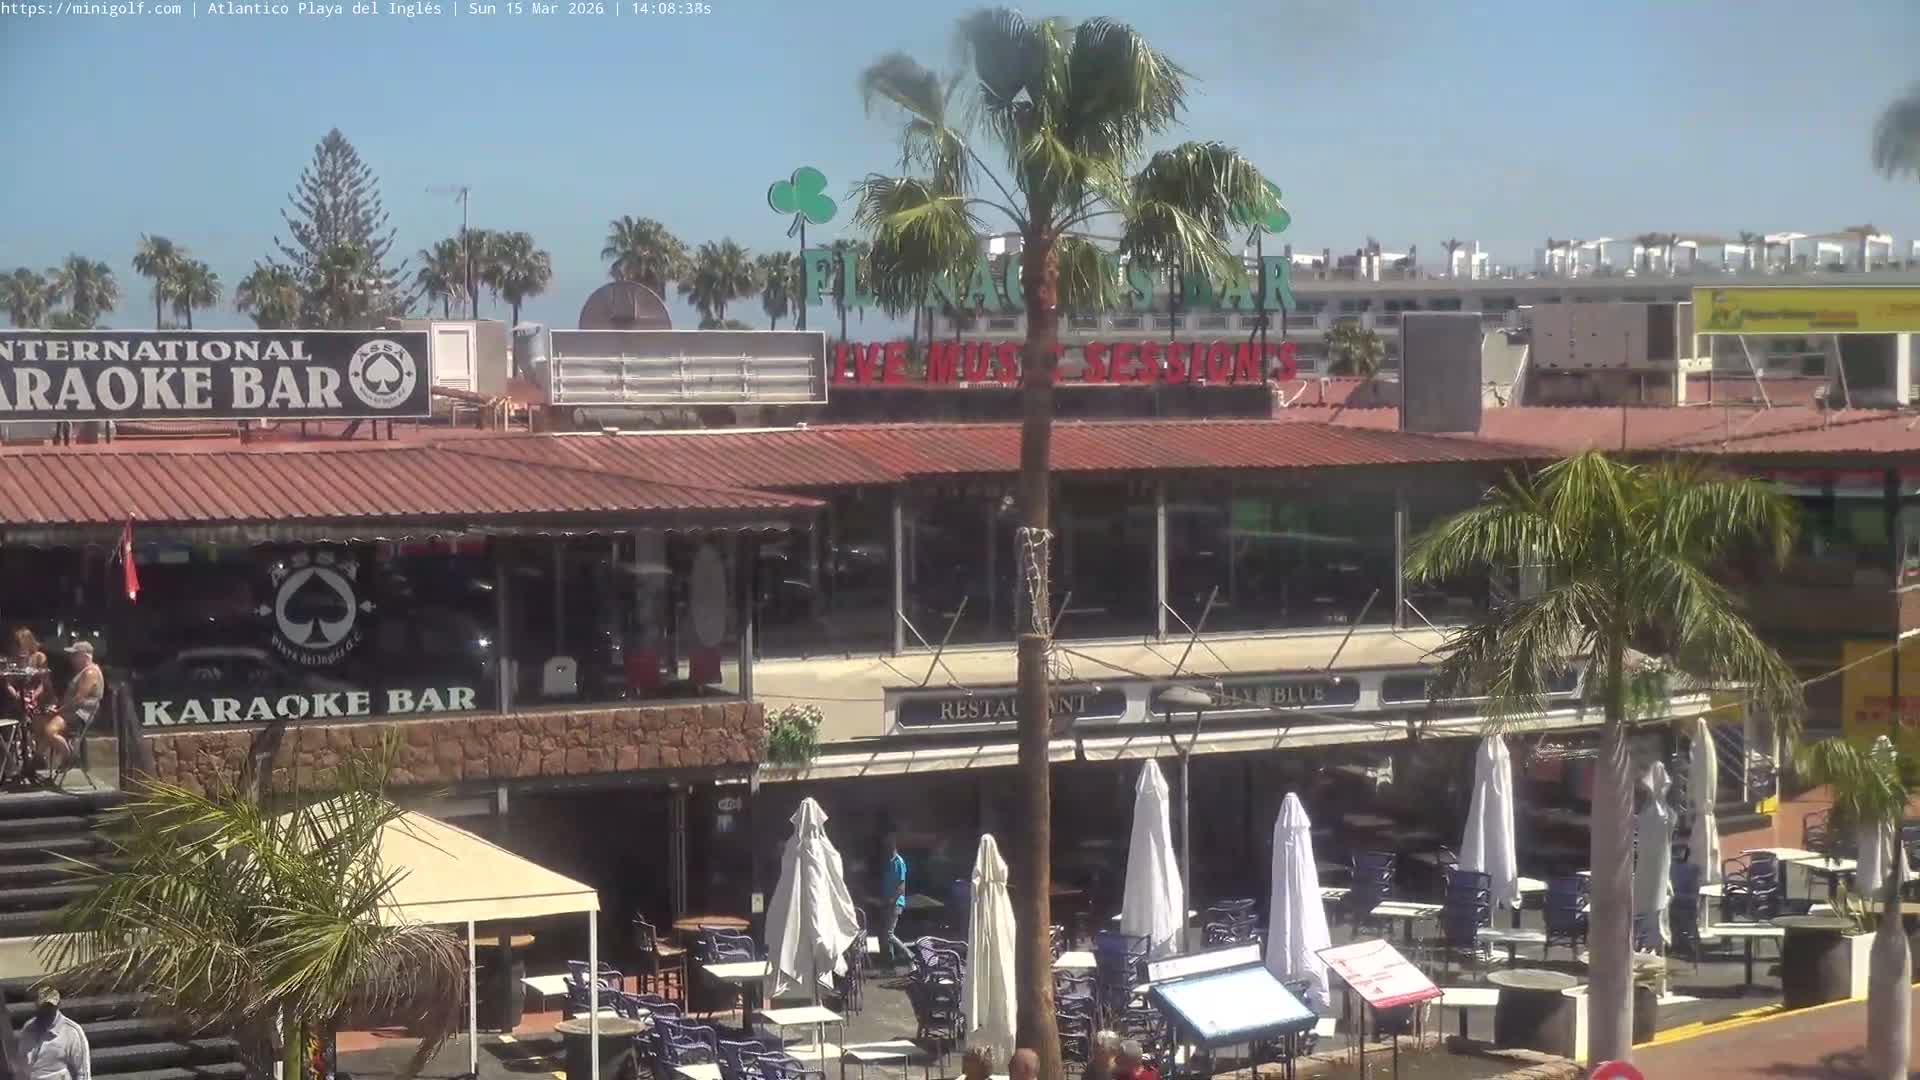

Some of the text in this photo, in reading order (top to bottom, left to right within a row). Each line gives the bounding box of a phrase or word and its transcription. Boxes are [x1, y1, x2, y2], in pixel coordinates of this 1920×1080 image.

[231, 366, 343, 409] BAR
[141, 687, 476, 726] KARAOKE BAR
[940, 696, 1086, 720] RESTAUANT
[1274, 684, 1324, 705] BLUE
